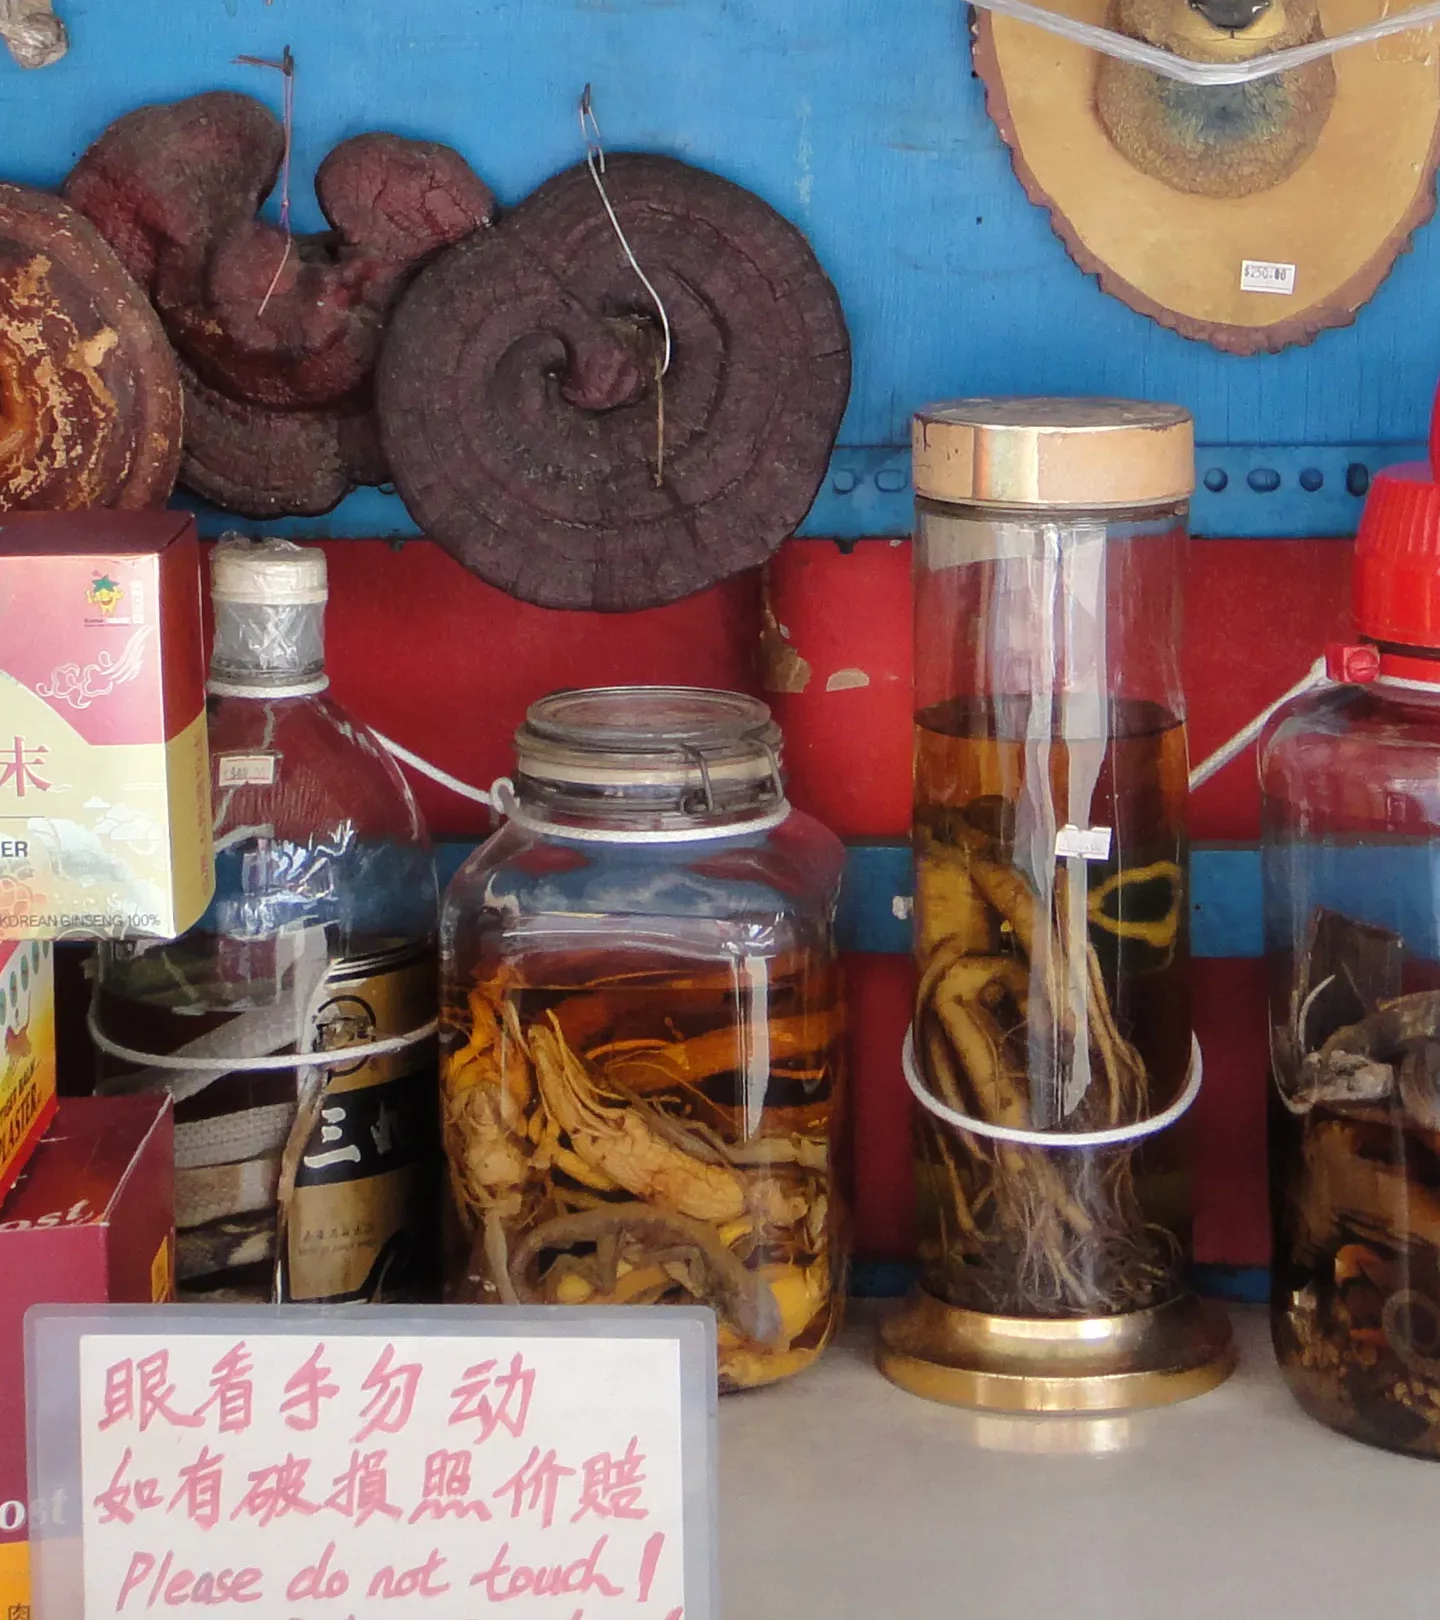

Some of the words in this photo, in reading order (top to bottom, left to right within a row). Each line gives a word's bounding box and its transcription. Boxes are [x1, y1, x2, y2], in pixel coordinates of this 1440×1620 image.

[0, 913, 57, 928] KOREAN
[60, 913, 123, 928] GINSENG
[126, 912, 162, 927] 100%
[97, 1340, 537, 1445] 眼看手勿动
[116, 1546, 262, 1612] Please
[287, 1541, 349, 1602] do
[366, 1547, 451, 1599] not
